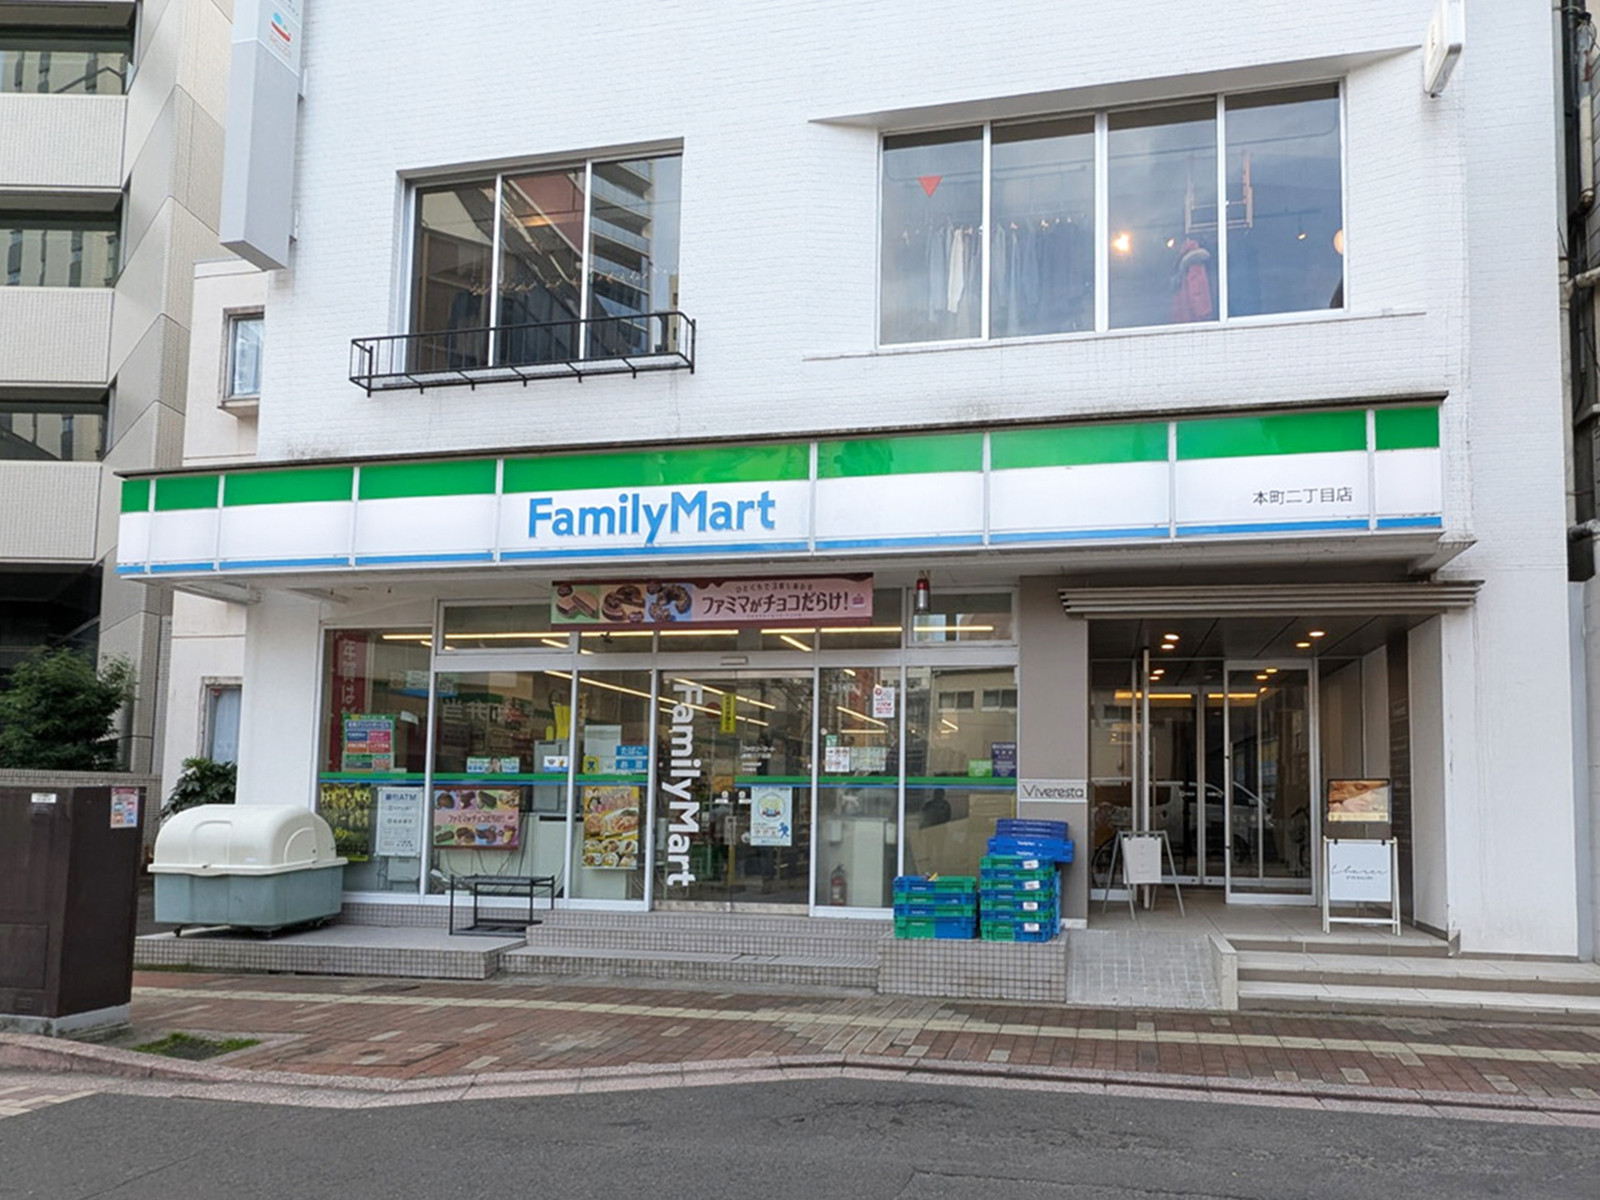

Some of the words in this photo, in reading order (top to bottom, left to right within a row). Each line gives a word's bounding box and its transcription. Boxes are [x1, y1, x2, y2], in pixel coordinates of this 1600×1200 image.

[1252, 487, 1353, 506] 本町二丁目店
[528, 489, 776, 545] FamilyMart
[661, 684, 703, 887] FamilyMart
[1022, 784, 1084, 799] Viveresta
